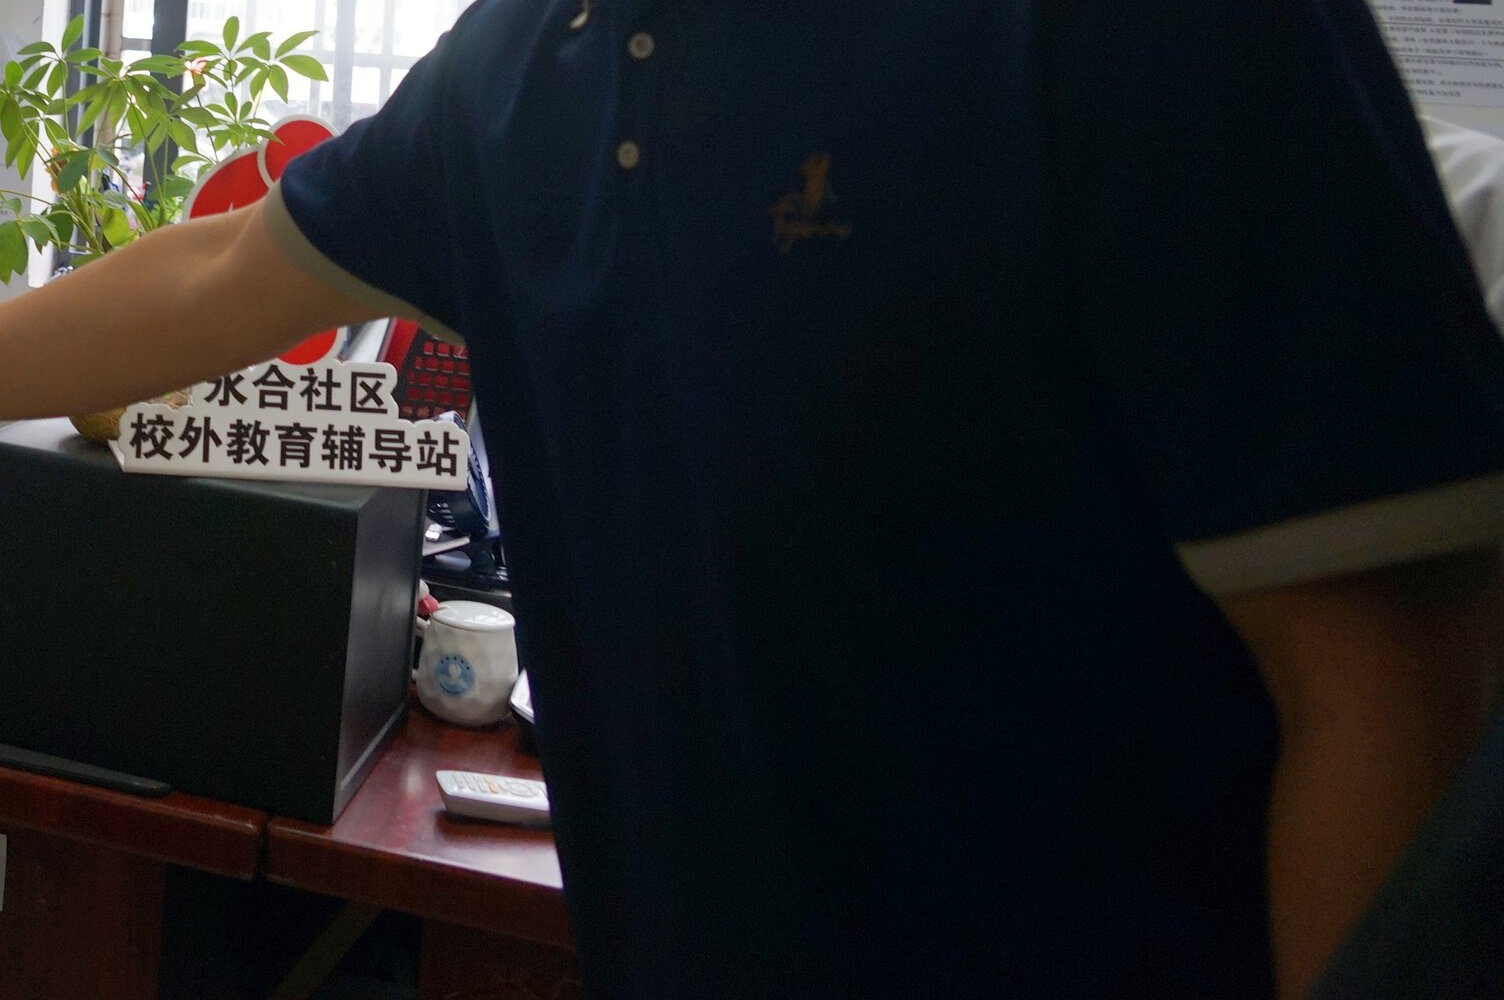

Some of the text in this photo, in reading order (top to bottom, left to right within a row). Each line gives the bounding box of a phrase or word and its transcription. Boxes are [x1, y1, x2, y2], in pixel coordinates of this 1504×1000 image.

[130, 412, 459, 477] 校外教育辅导站
